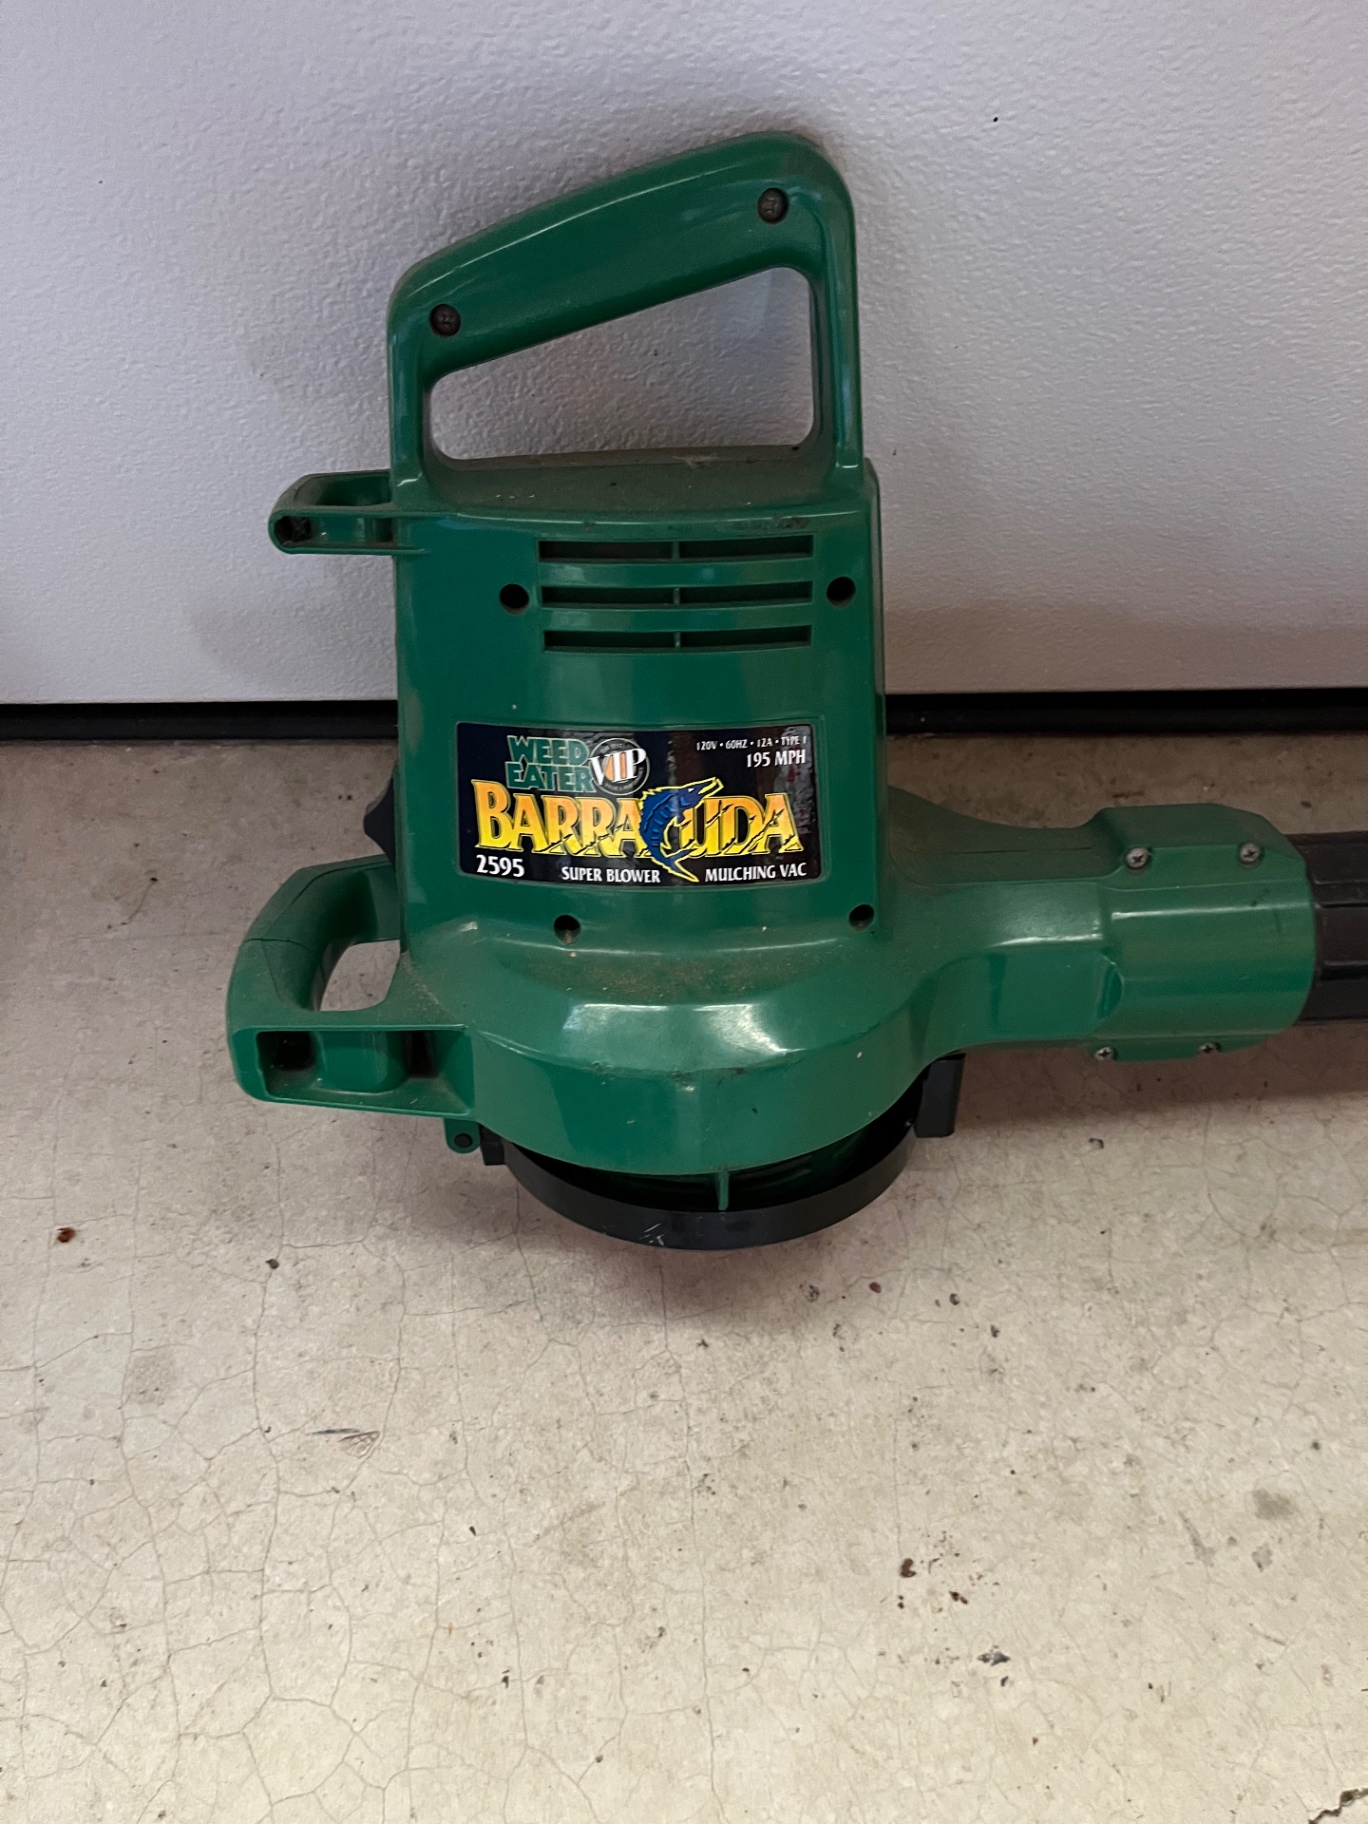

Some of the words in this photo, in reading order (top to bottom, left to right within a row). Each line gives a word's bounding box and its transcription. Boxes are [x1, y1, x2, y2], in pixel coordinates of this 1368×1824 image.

[507, 735, 590, 766] WEED
[696, 740, 718, 751] 120V
[725, 739, 748, 750] 60HZ
[757, 738, 773, 748] 12A
[781, 735, 800, 746] TYPE
[588, 748, 647, 786] VIP
[746, 751, 771, 768] 195
[774, 749, 806, 766] MPH
[505, 761, 597, 793] EATER
[476, 855, 525, 878] 2595
[561, 866, 602, 882] SUPER
[606, 867, 661, 883] BLOWER
[705, 865, 776, 882] MULCHING
[780, 862, 807, 877] VAC
